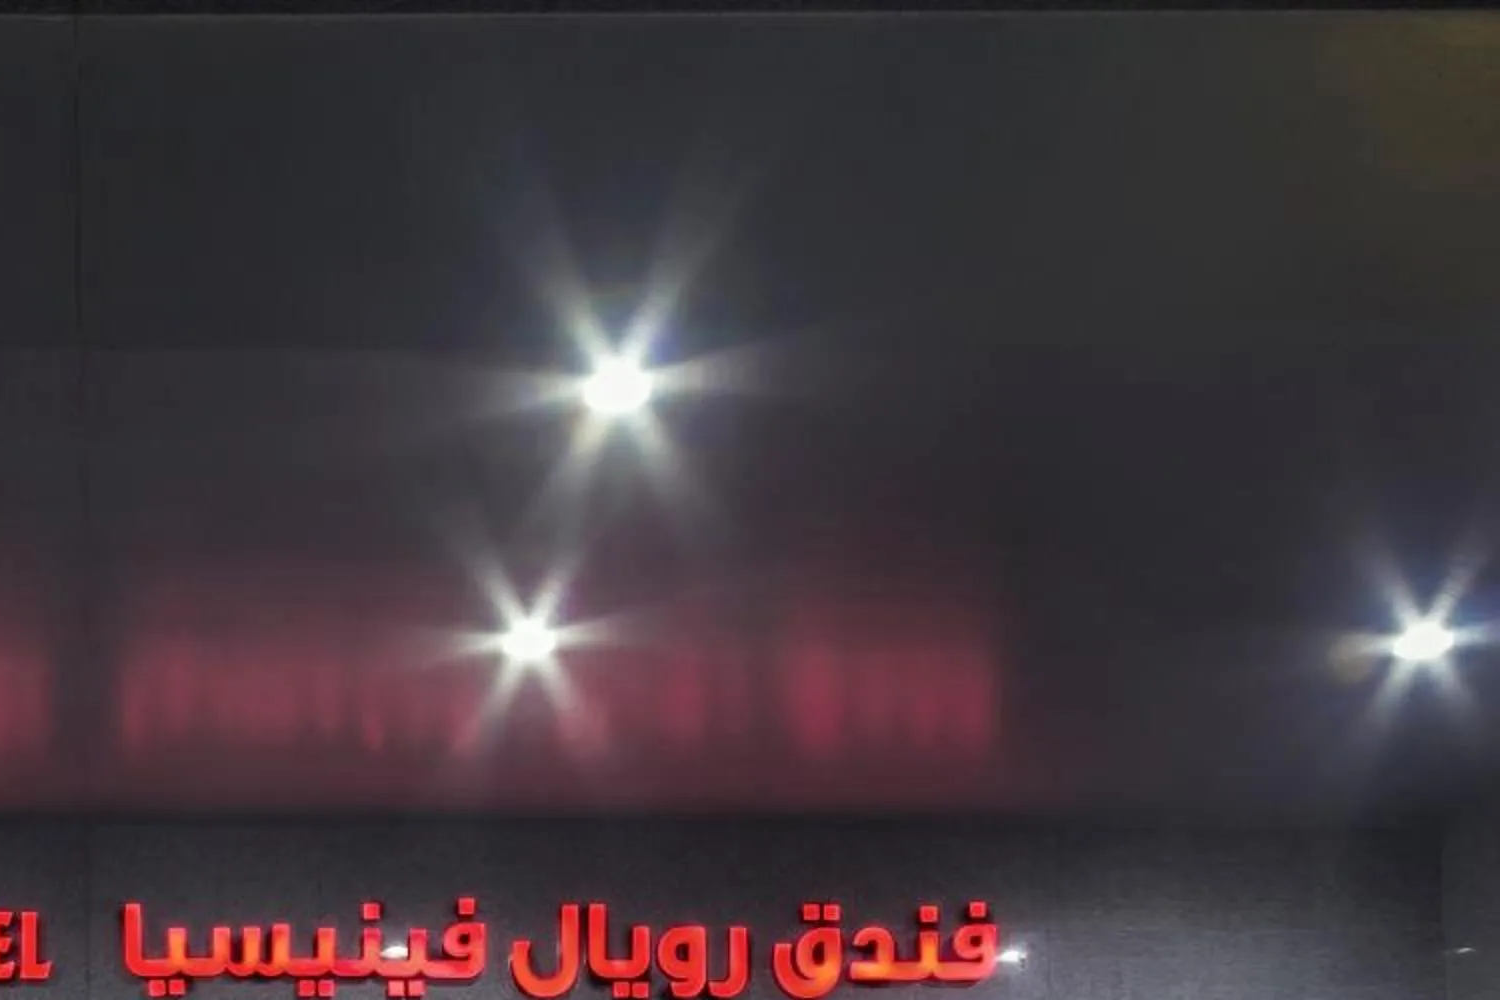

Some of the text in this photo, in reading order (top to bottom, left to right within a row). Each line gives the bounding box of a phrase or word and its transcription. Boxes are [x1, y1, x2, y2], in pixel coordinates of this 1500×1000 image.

[123, 897, 999, 1000] فندق رويال فينيسيا
